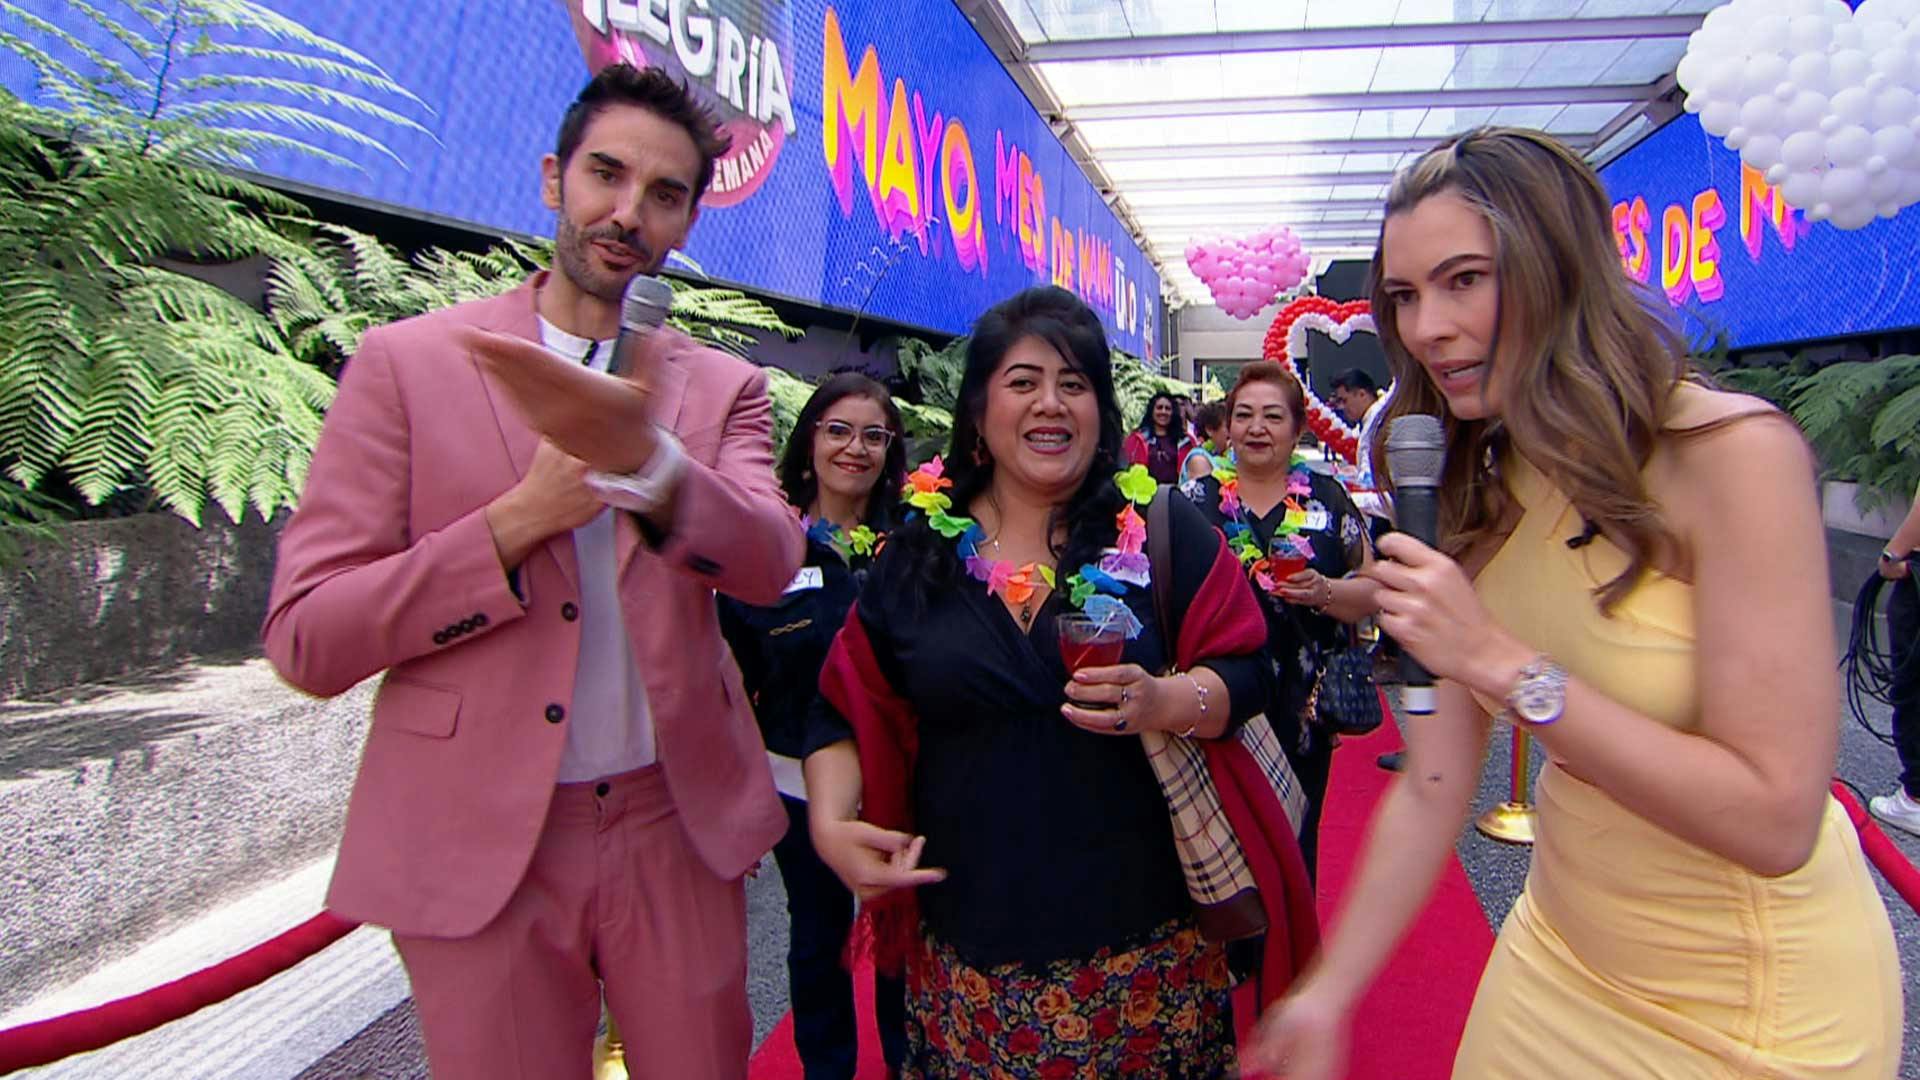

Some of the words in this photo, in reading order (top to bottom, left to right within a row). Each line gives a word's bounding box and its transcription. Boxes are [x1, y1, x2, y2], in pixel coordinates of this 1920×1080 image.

[705, 128, 774, 193] EMANA
[996, 128, 1046, 278] MES
[1052, 216, 1074, 290] DE
[1612, 195, 1650, 284] ES
[1662, 188, 1726, 302] DE
